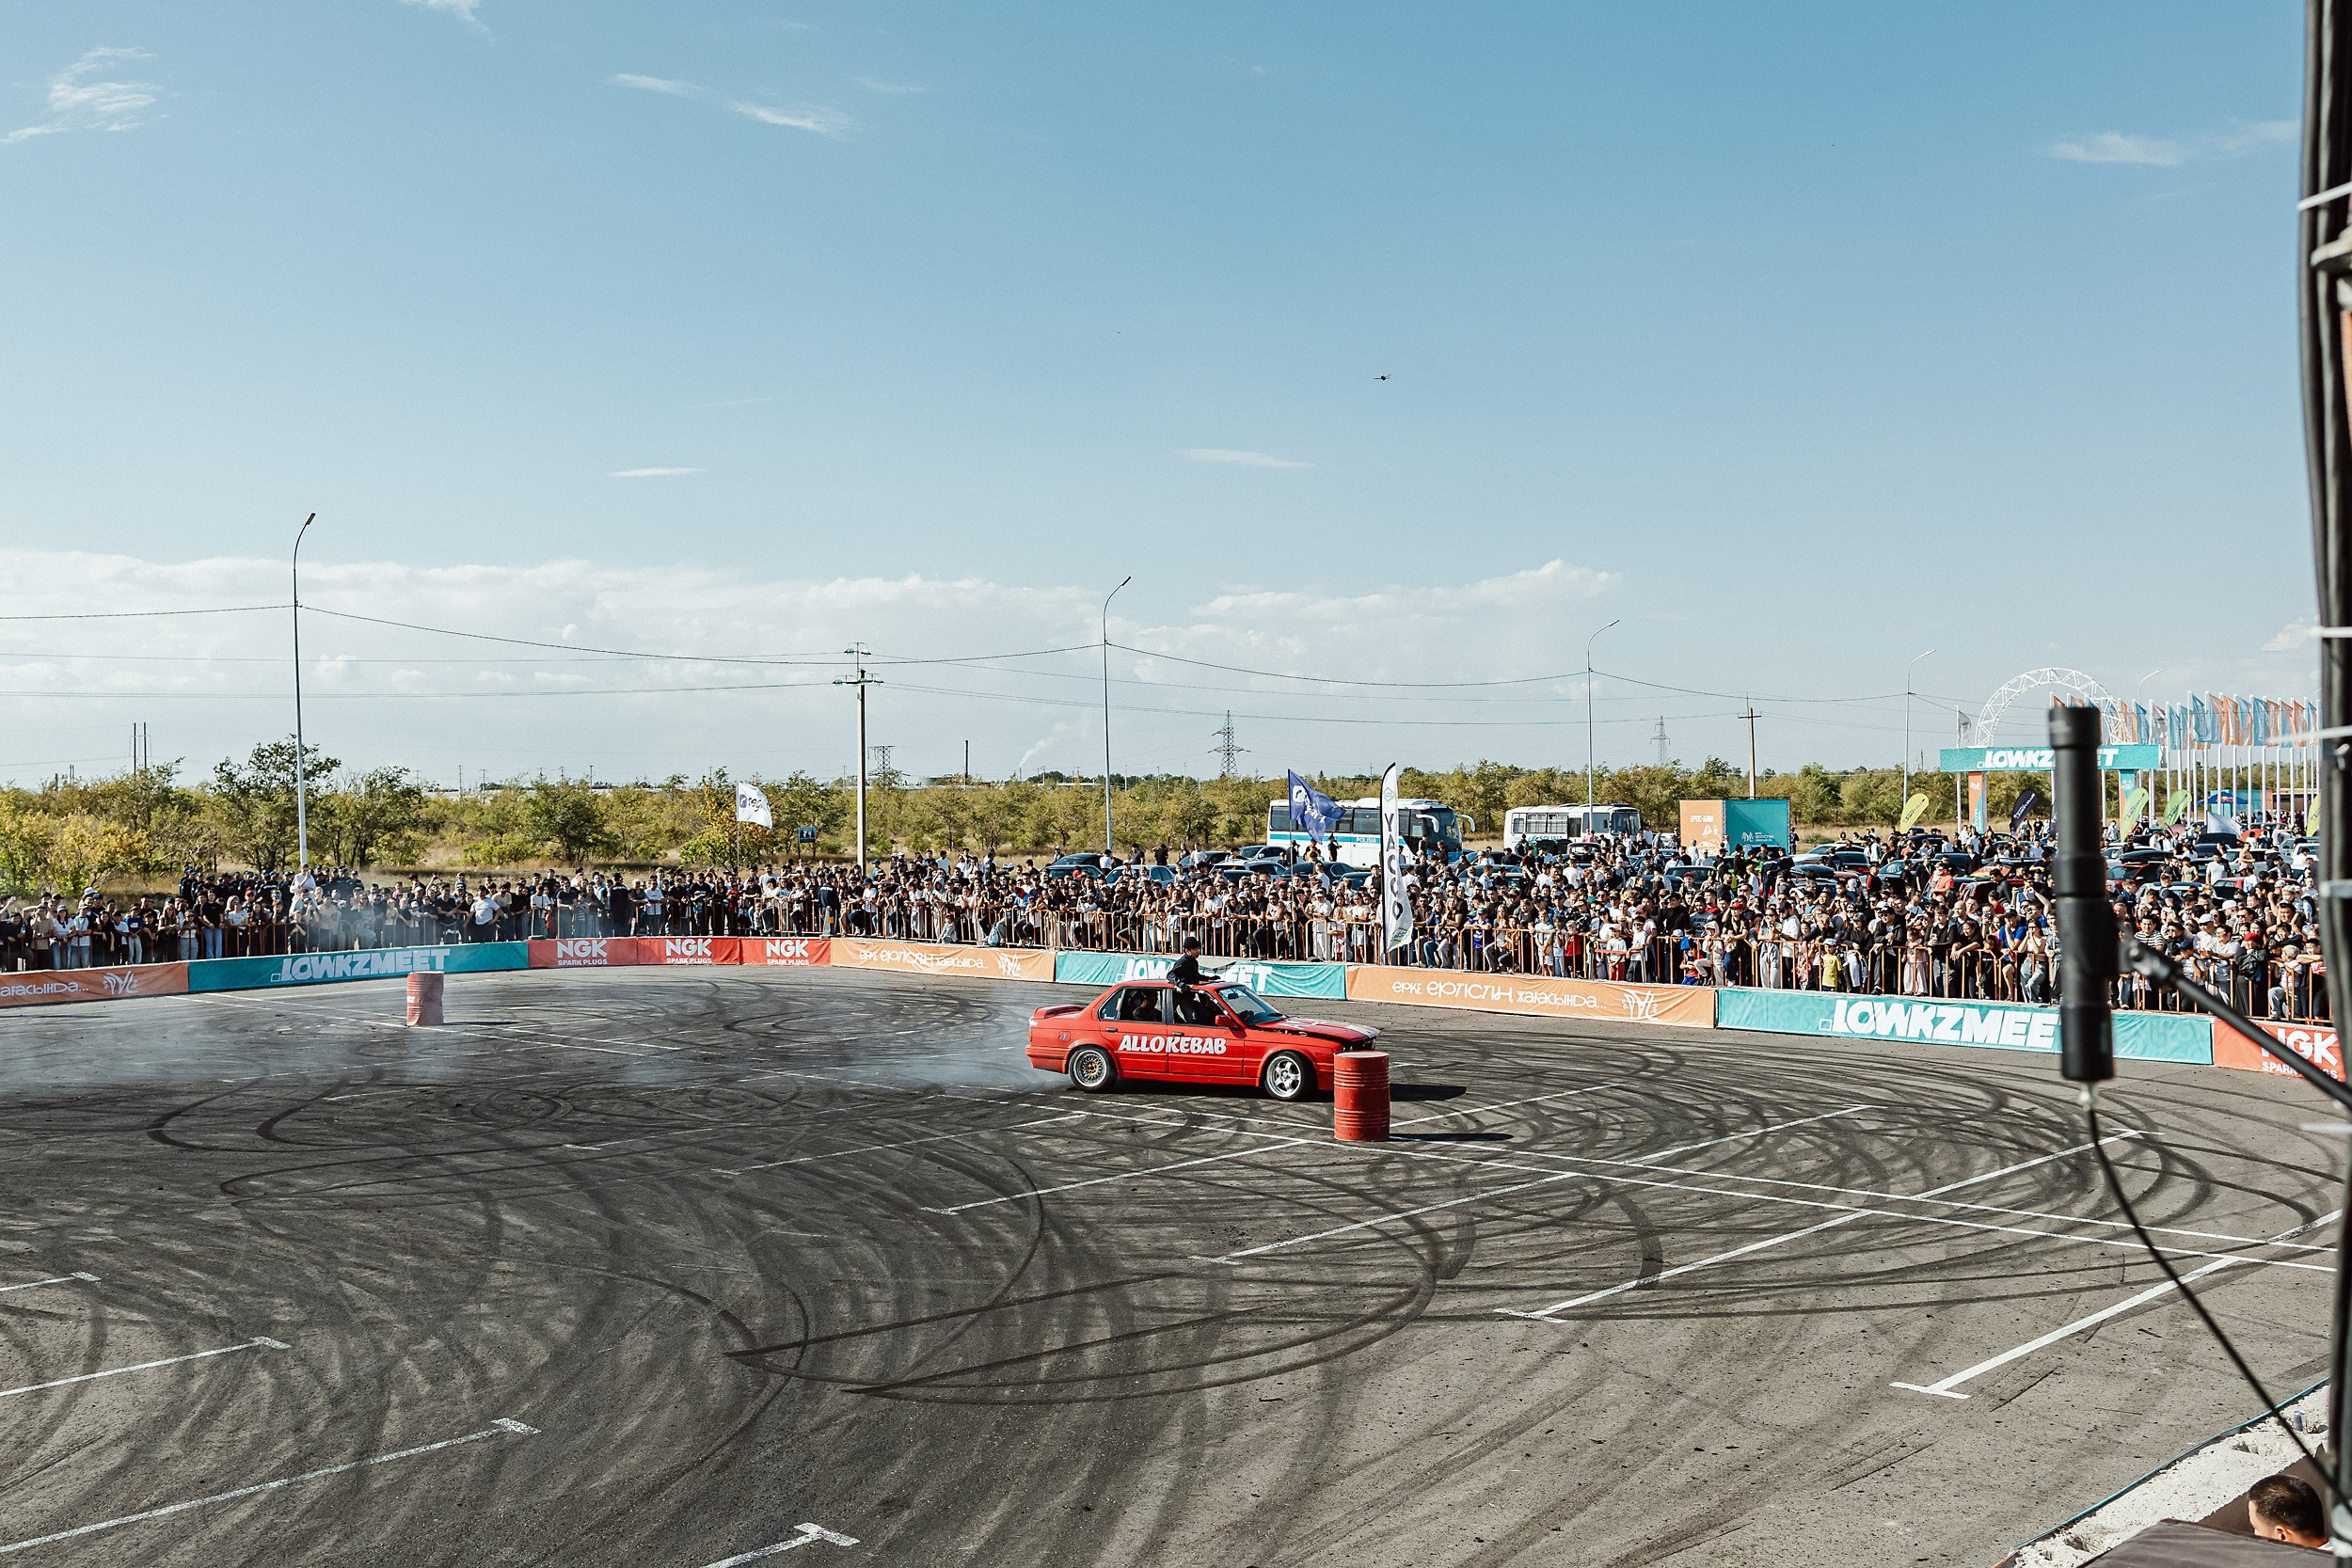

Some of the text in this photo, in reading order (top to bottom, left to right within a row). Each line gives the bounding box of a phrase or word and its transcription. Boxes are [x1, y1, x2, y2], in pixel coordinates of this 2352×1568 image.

[1984, 749, 2119, 768] LOWKZT
[557, 939, 608, 958] NGK
[665, 938, 712, 957] NGK
[766, 939, 809, 958] NGK
[281, 948, 451, 982] LOWKZMEET
[1124, 958, 1272, 992] LOWEET
[1832, 999, 2061, 1049] LOWKZMEE
